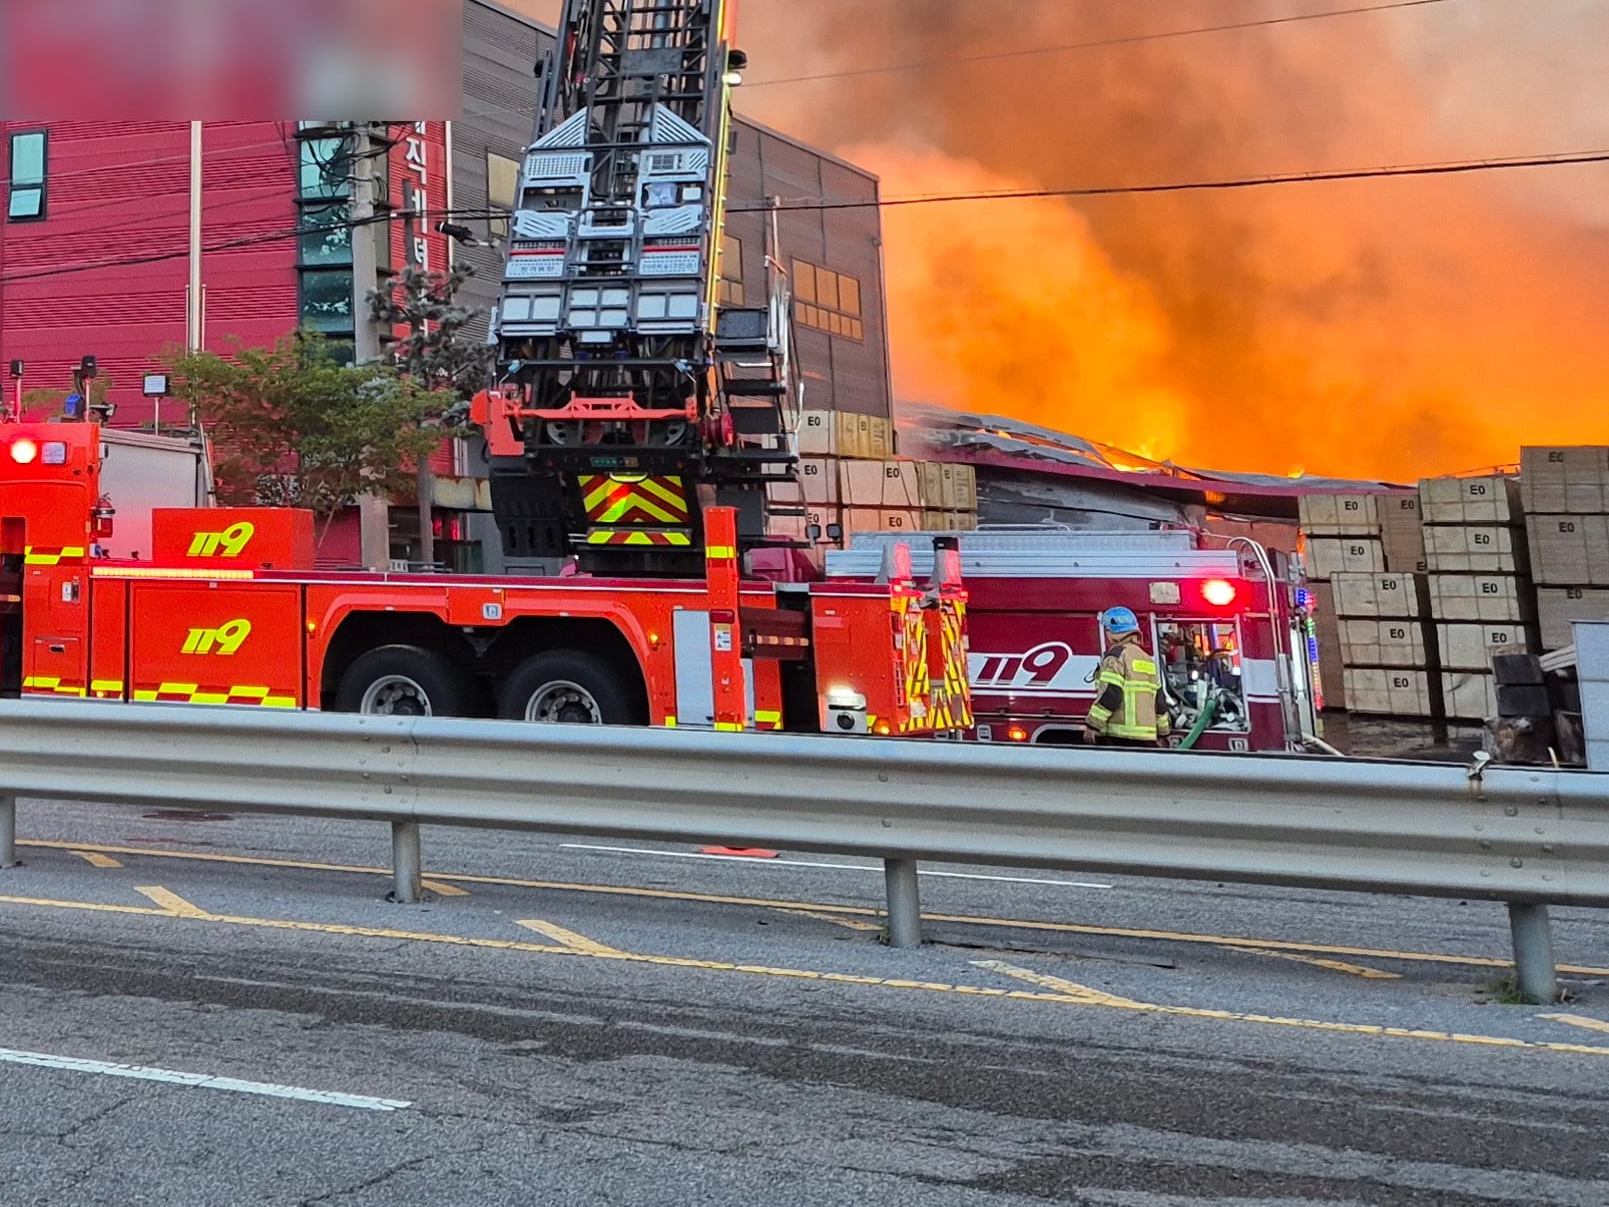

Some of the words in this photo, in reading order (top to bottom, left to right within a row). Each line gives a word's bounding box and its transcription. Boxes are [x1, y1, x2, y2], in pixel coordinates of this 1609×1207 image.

[807, 416, 821, 427] E0
[804, 464, 818, 476] E0
[885, 467, 900, 479] E0
[1469, 484, 1486, 496] E0
[1344, 500, 1359, 511] E0
[1400, 499, 1416, 510] E0
[888, 516, 903, 528] E0
[1558, 521, 1575, 533] E0
[186, 521, 255, 557] 119
[1474, 533, 1490, 545] E0
[1350, 545, 1365, 556] E0
[1381, 579, 1397, 591] E0
[1481, 582, 1498, 594] E0
[180, 618, 252, 655] 119
[1389, 628, 1405, 640] E0
[1491, 632, 1508, 644] E0
[974, 644, 1070, 687] 119
[1393, 677, 1409, 688] E0
